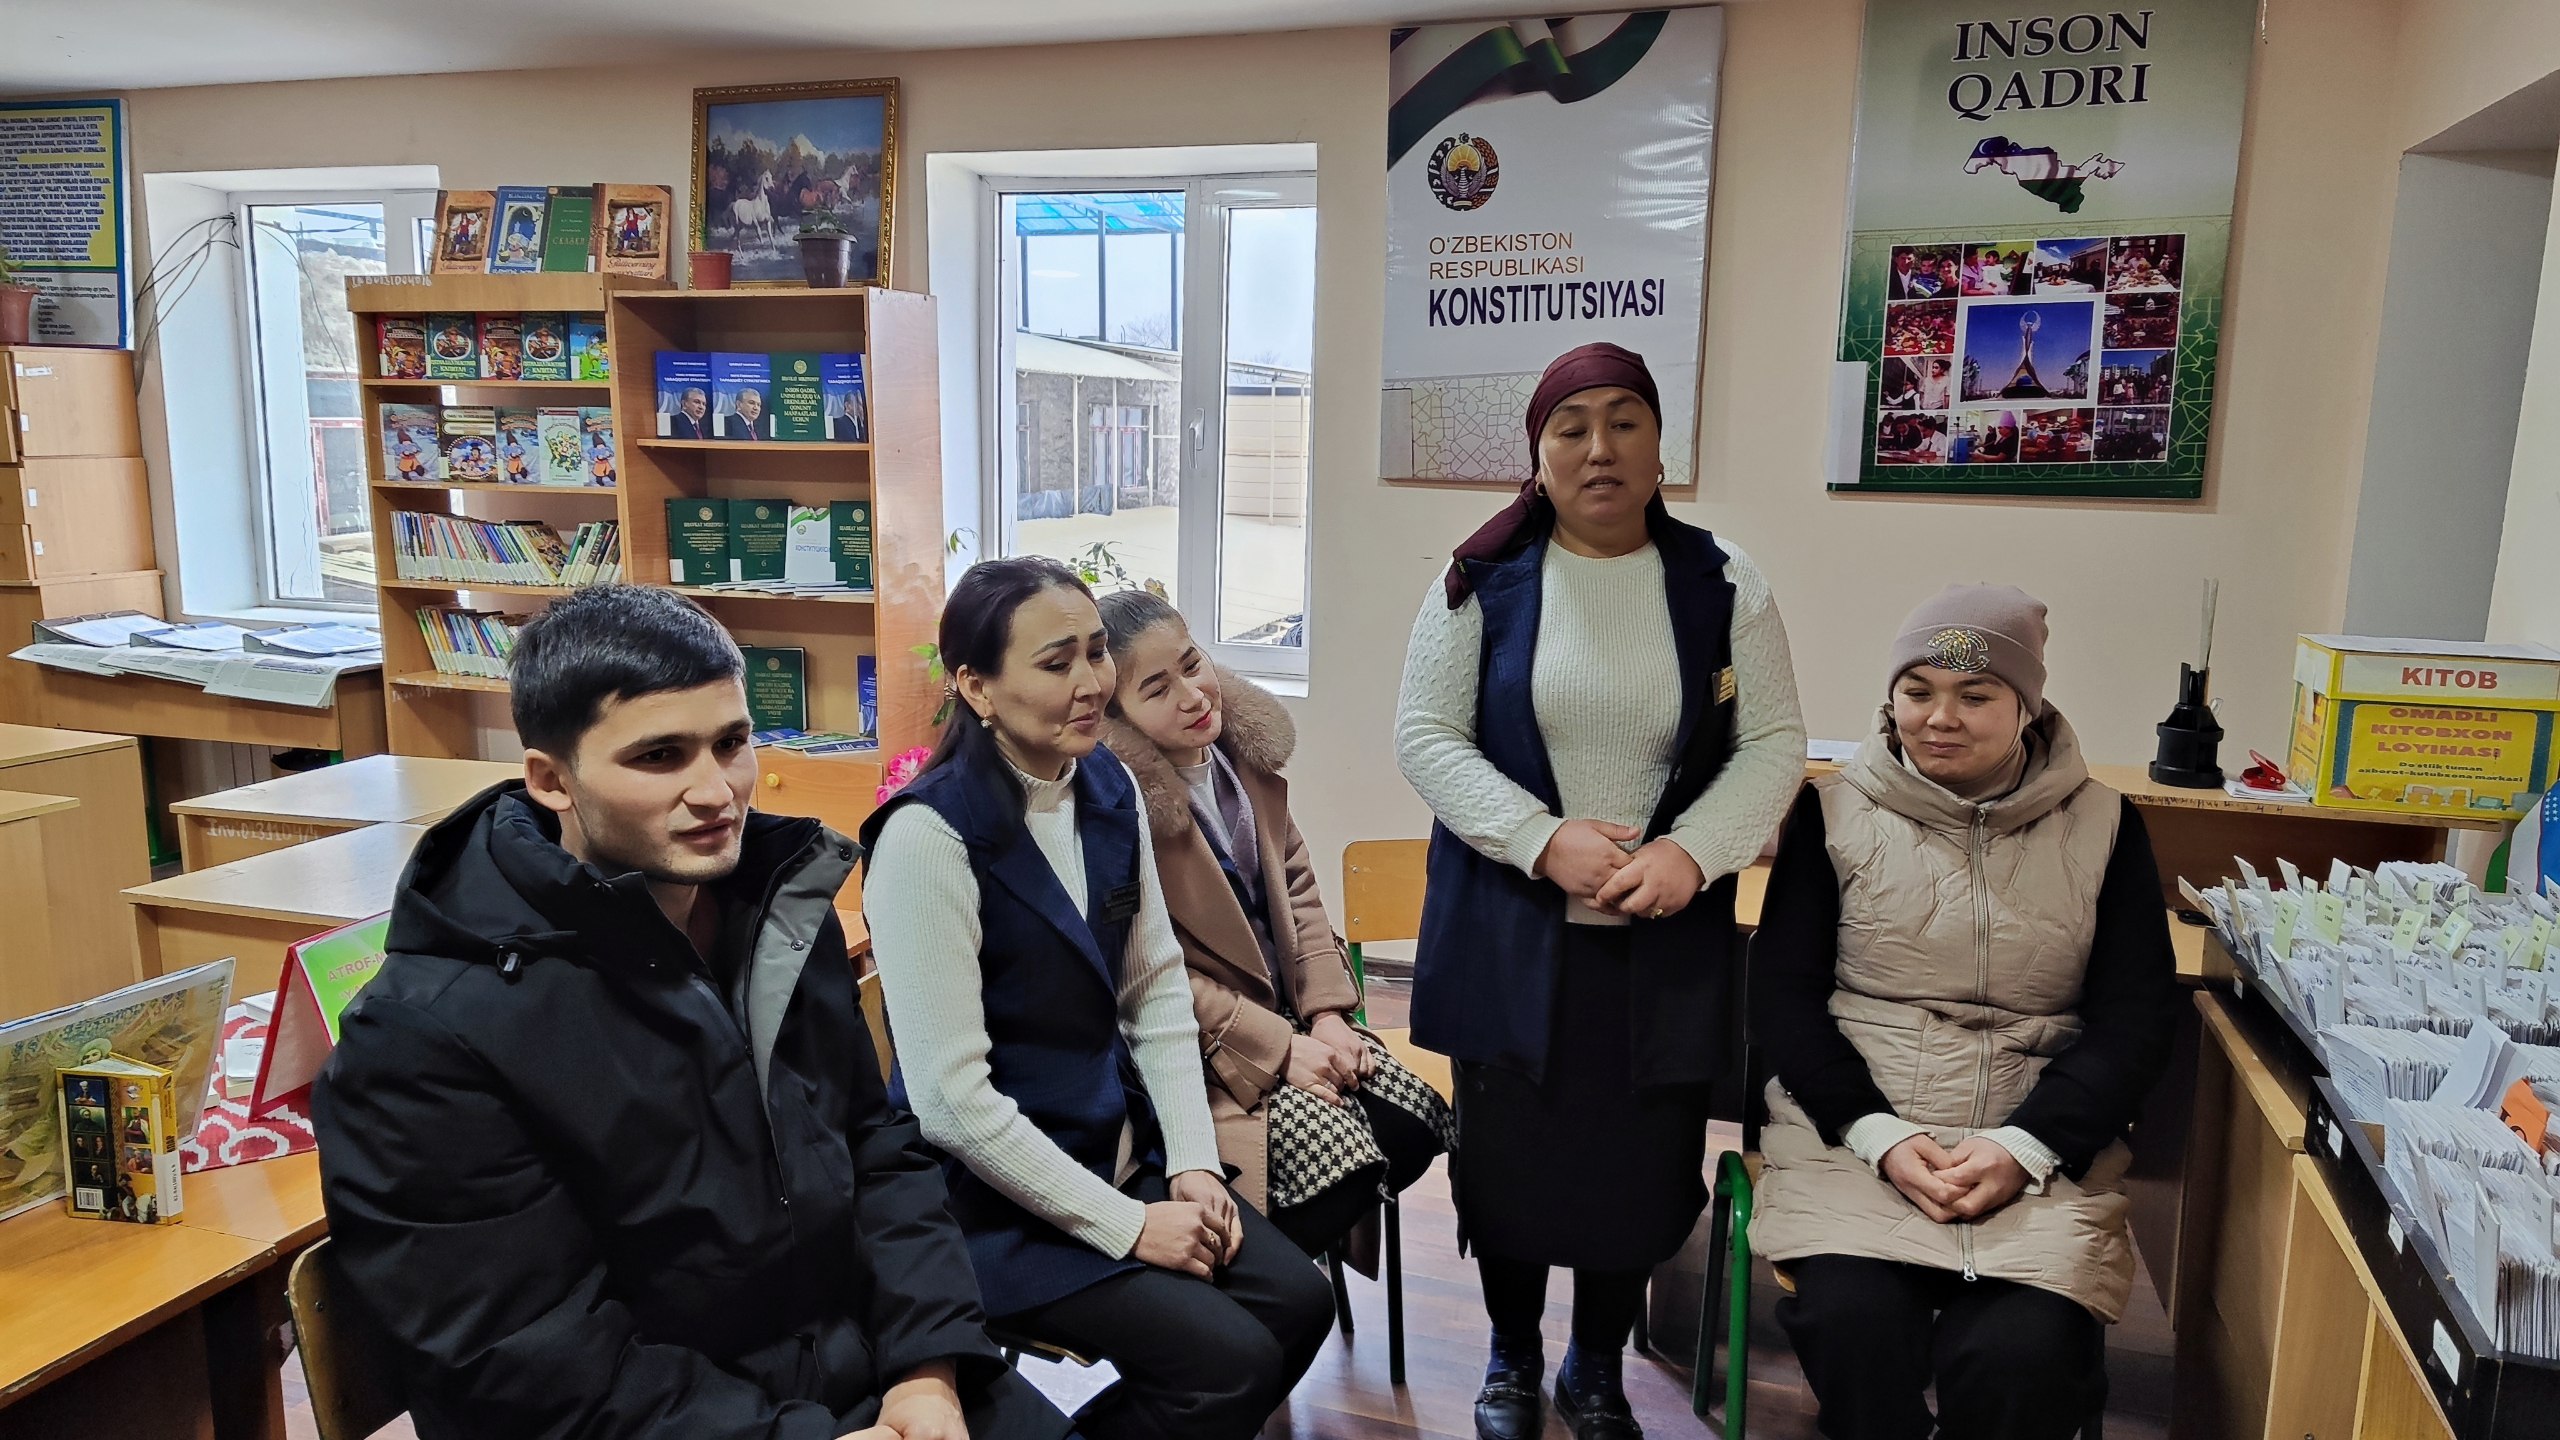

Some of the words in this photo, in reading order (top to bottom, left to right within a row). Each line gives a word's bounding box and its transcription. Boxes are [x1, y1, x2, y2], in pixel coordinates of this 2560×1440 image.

[1953, 10, 2154, 62] INSON
[1947, 63, 2152, 121] QADRI
[1430, 256, 1585, 279] RESPUBLIKASI
[1429, 278, 1664, 327] KONSTITUTSIYASI
[705, 561, 711, 569] 6
[2402, 667, 2498, 690] KITOB
[2389, 708, 2498, 723] OMADLI
[2371, 724, 2512, 742] KITOBXON
[2378, 742, 2502, 758] LOYIHASI
[2446, 763, 2483, 772] tuman
[2474, 774, 2524, 783] markazi
